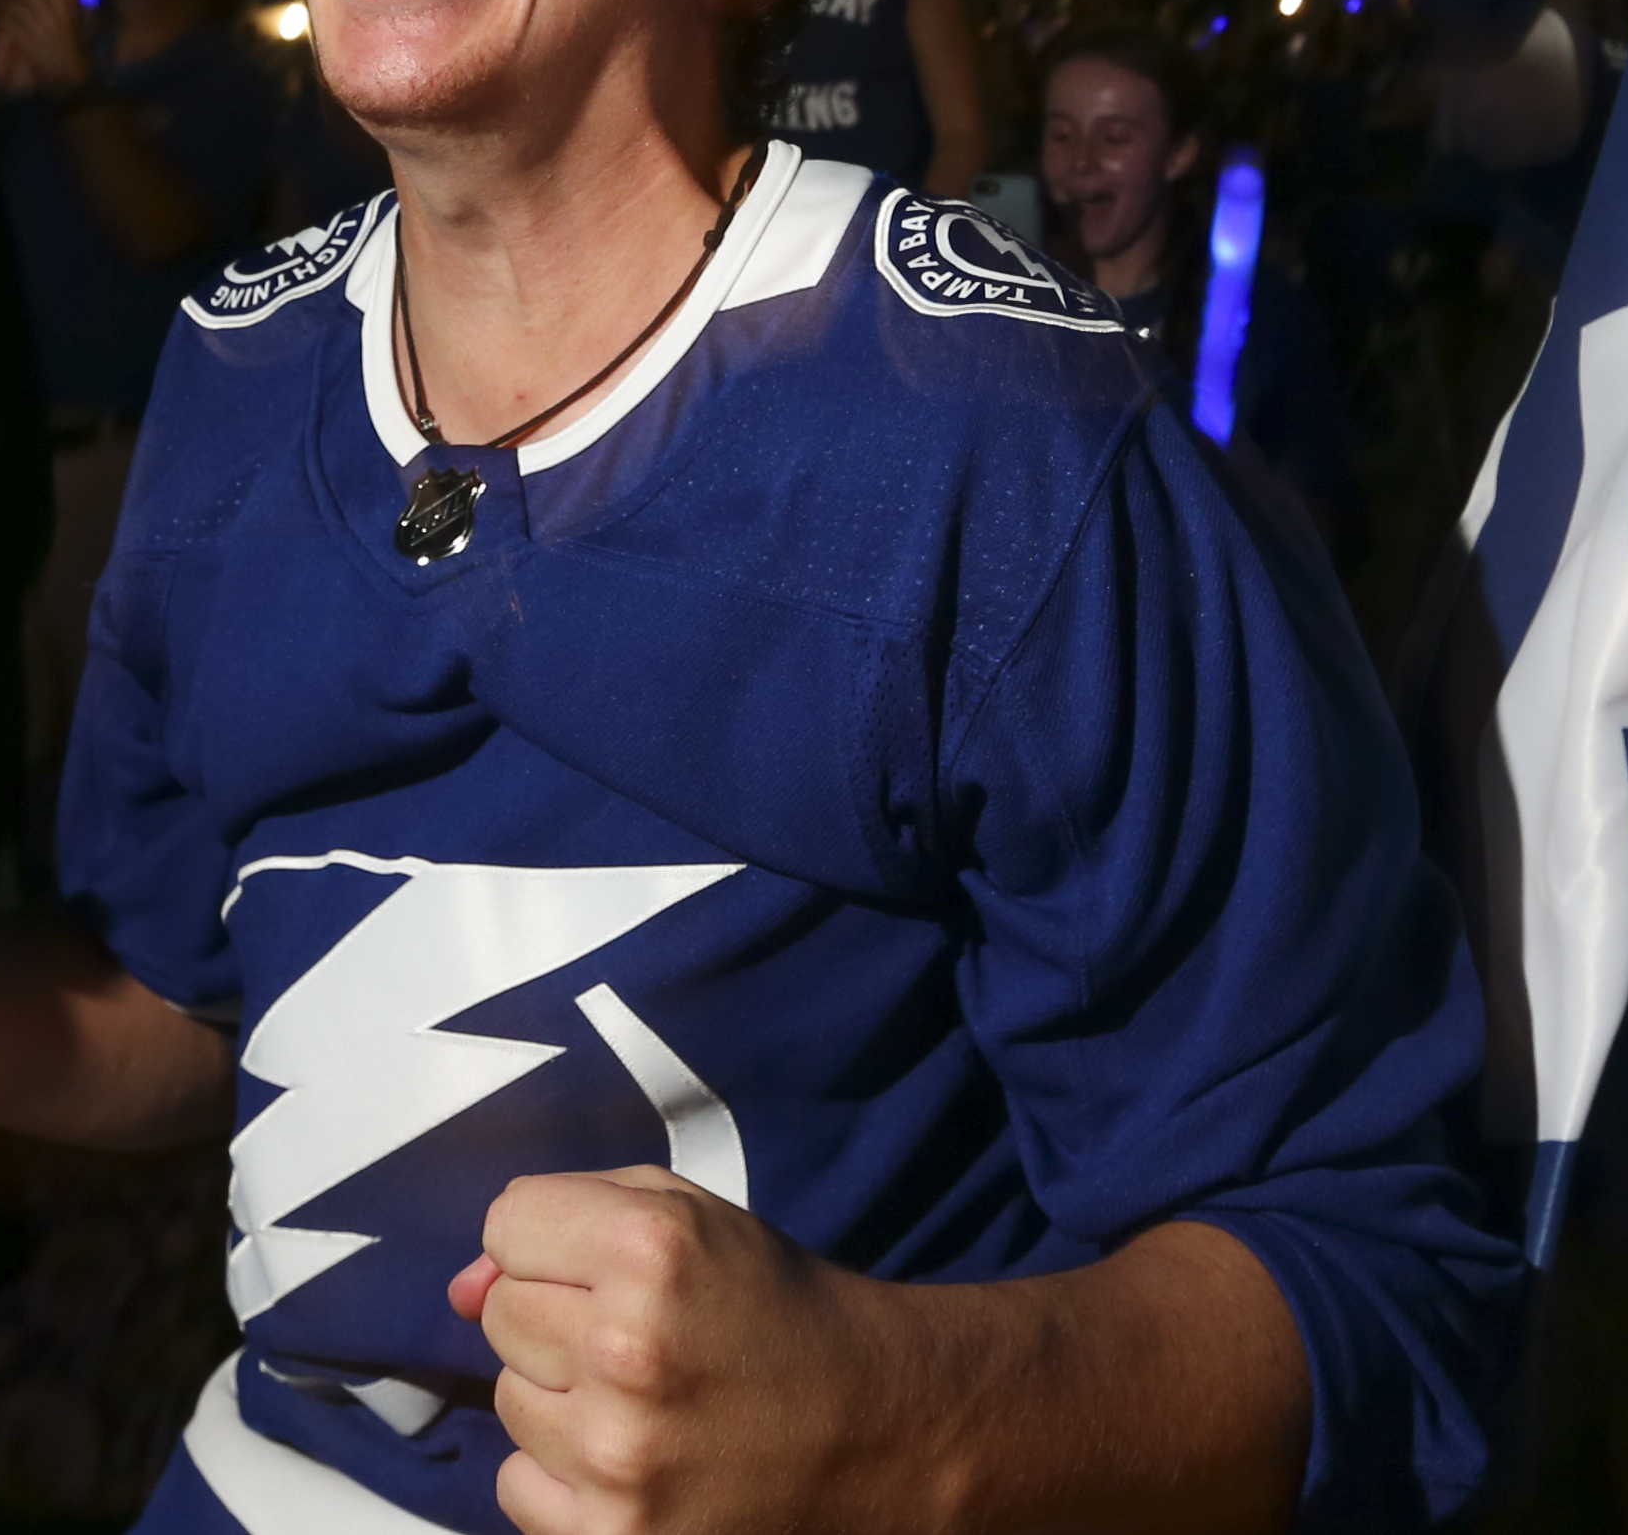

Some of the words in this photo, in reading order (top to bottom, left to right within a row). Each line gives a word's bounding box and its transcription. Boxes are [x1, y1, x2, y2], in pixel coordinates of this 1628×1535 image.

[898, 200, 936, 252] BAY
[209, 219, 358, 309] LIGHTNING
[906, 252, 1032, 304] TAMPA
